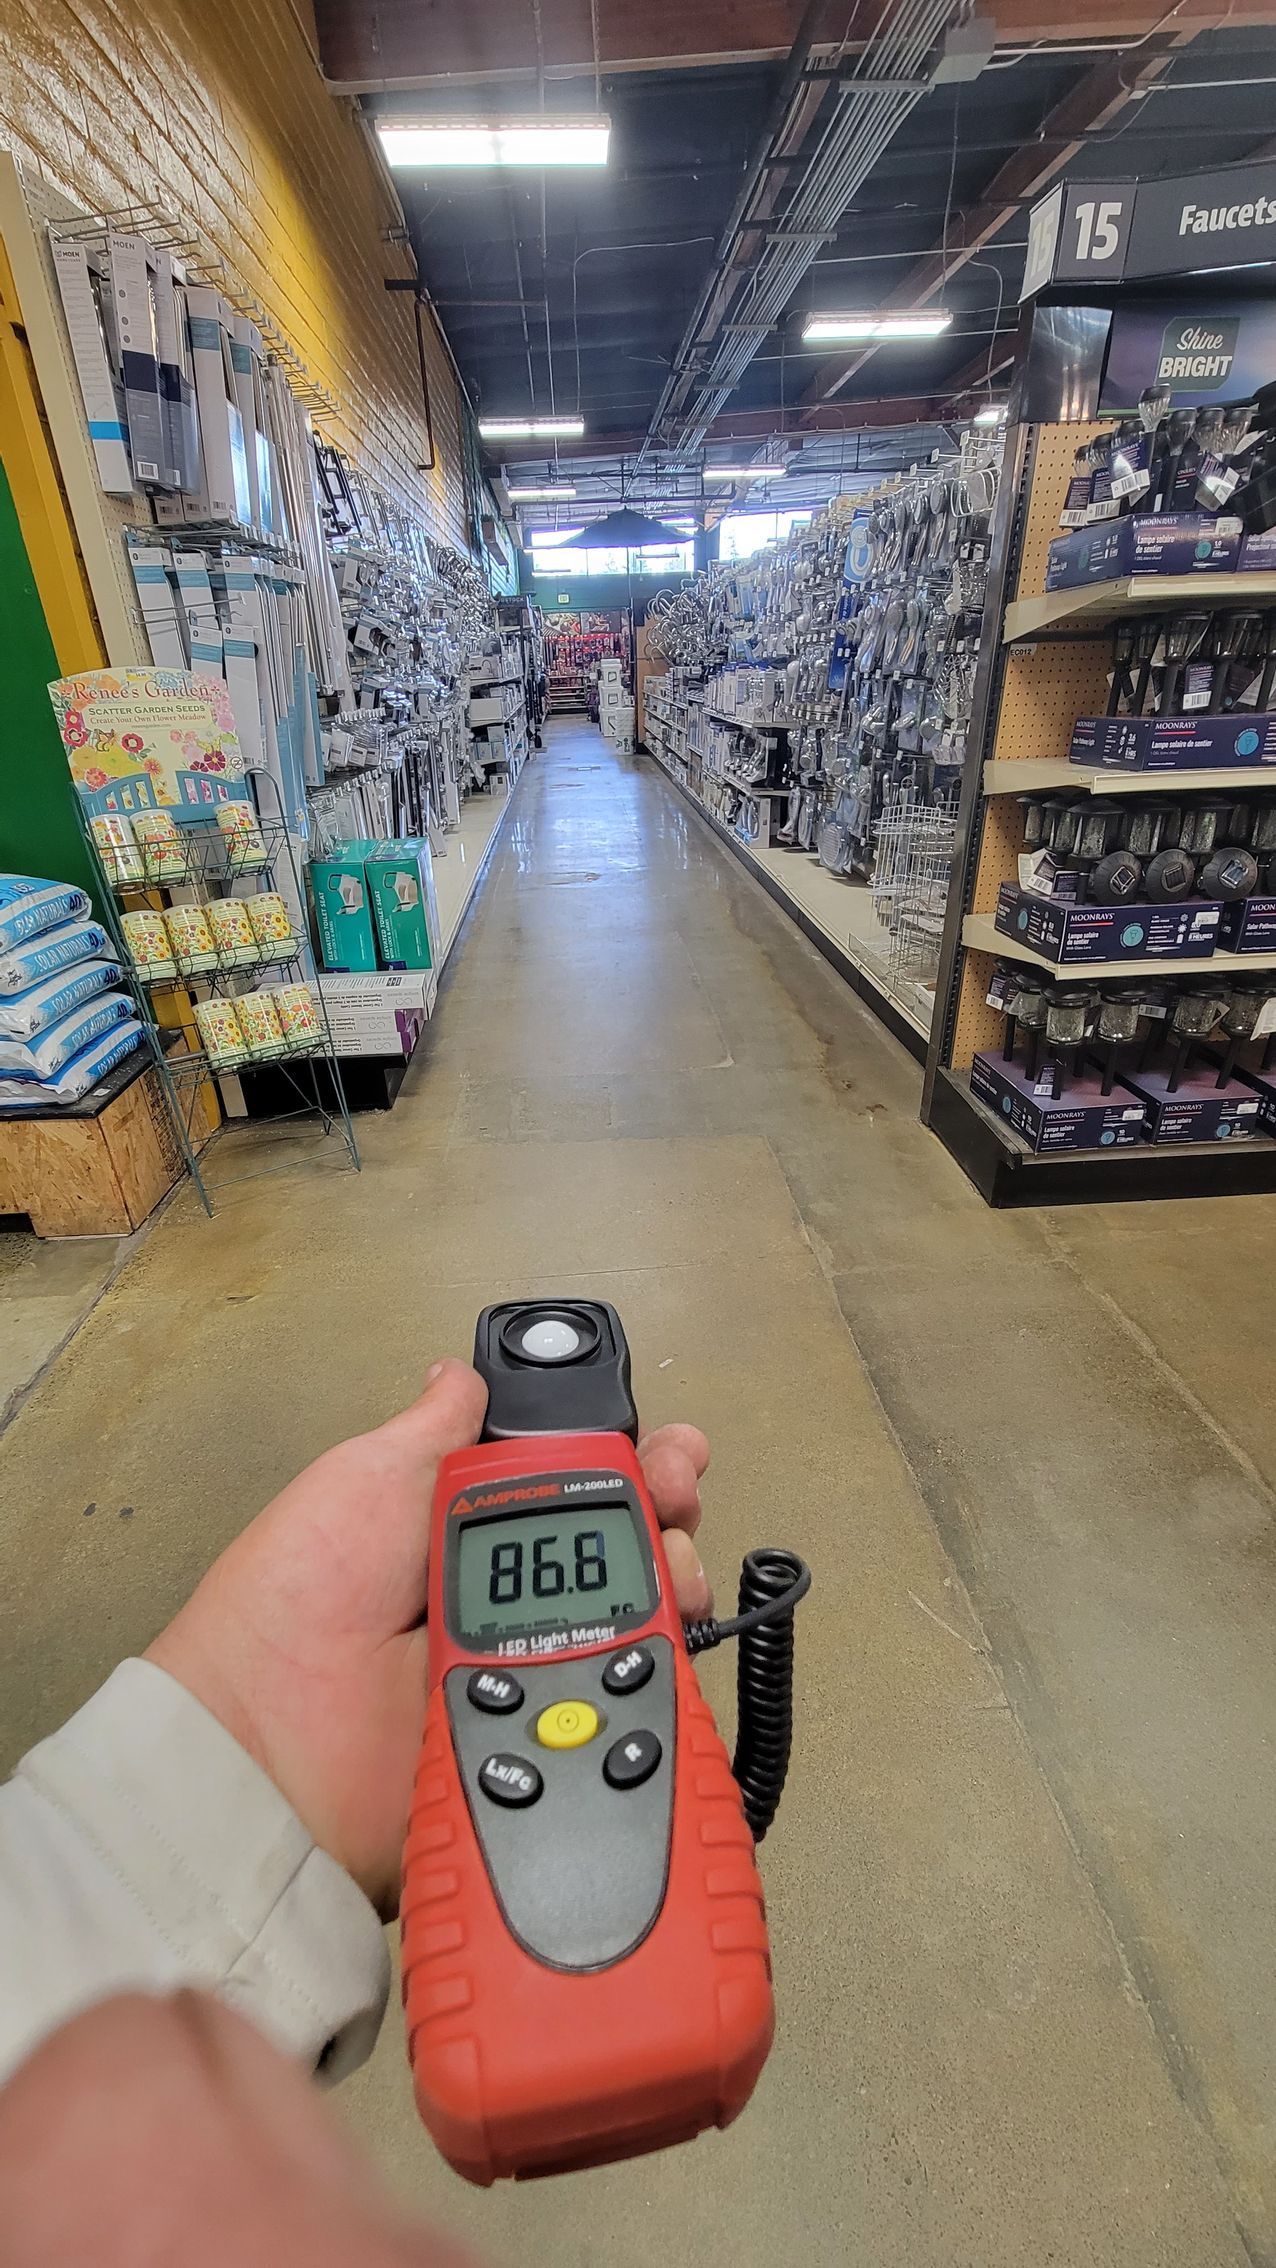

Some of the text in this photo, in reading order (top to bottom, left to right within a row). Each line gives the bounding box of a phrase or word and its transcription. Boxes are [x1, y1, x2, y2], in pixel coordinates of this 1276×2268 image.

[1178, 196, 1276, 236] Faucets
[1075, 202, 1123, 260] 15
[112, 241, 135, 250] MOEN
[1031, 210, 1054, 277] 15
[1176, 326, 1224, 350] Shine
[1158, 355, 1233, 378] BRIGHT
[74, 677, 209, 701] Renee's Garden
[89, 704, 206, 716] SCATTER GARDEN SEEDS
[90, 716, 114, 725] Create
[178, 713, 206, 721] Meadow
[1155, 722, 1196, 730] MOONRAYS
[1151, 740, 1169, 749] Lampe
[1169, 740, 1187, 748] solaire
[1194, 739, 1213, 747] sentier
[318, 891, 334, 961] ELEVATED TOILET SEAT
[374, 890, 390, 959] ELEVATED TOILET SEAT
[1070, 913, 1114, 922] MOONRAYS
[1066, 938, 1076, 946] de
[1083, 931, 1099, 939] solaire
[34, 935, 90, 973] SOLAR NATURALS
[1046, 1112, 1085, 1120] MOONRAYS
[1164, 1103, 1203, 1112] MOONRAYS
[473, 1478, 623, 1507] AMPROBE LM-200LED
[489, 1530, 608, 1605] 86.8
[498, 1639, 529, 1657] LED
[531, 1631, 568, 1655] Light
[571, 1625, 616, 1646] Meter
[613, 1650, 643, 1678] D-H
[624, 1742, 642, 1762] R
[485, 1757, 531, 1791] Lx/Fc
